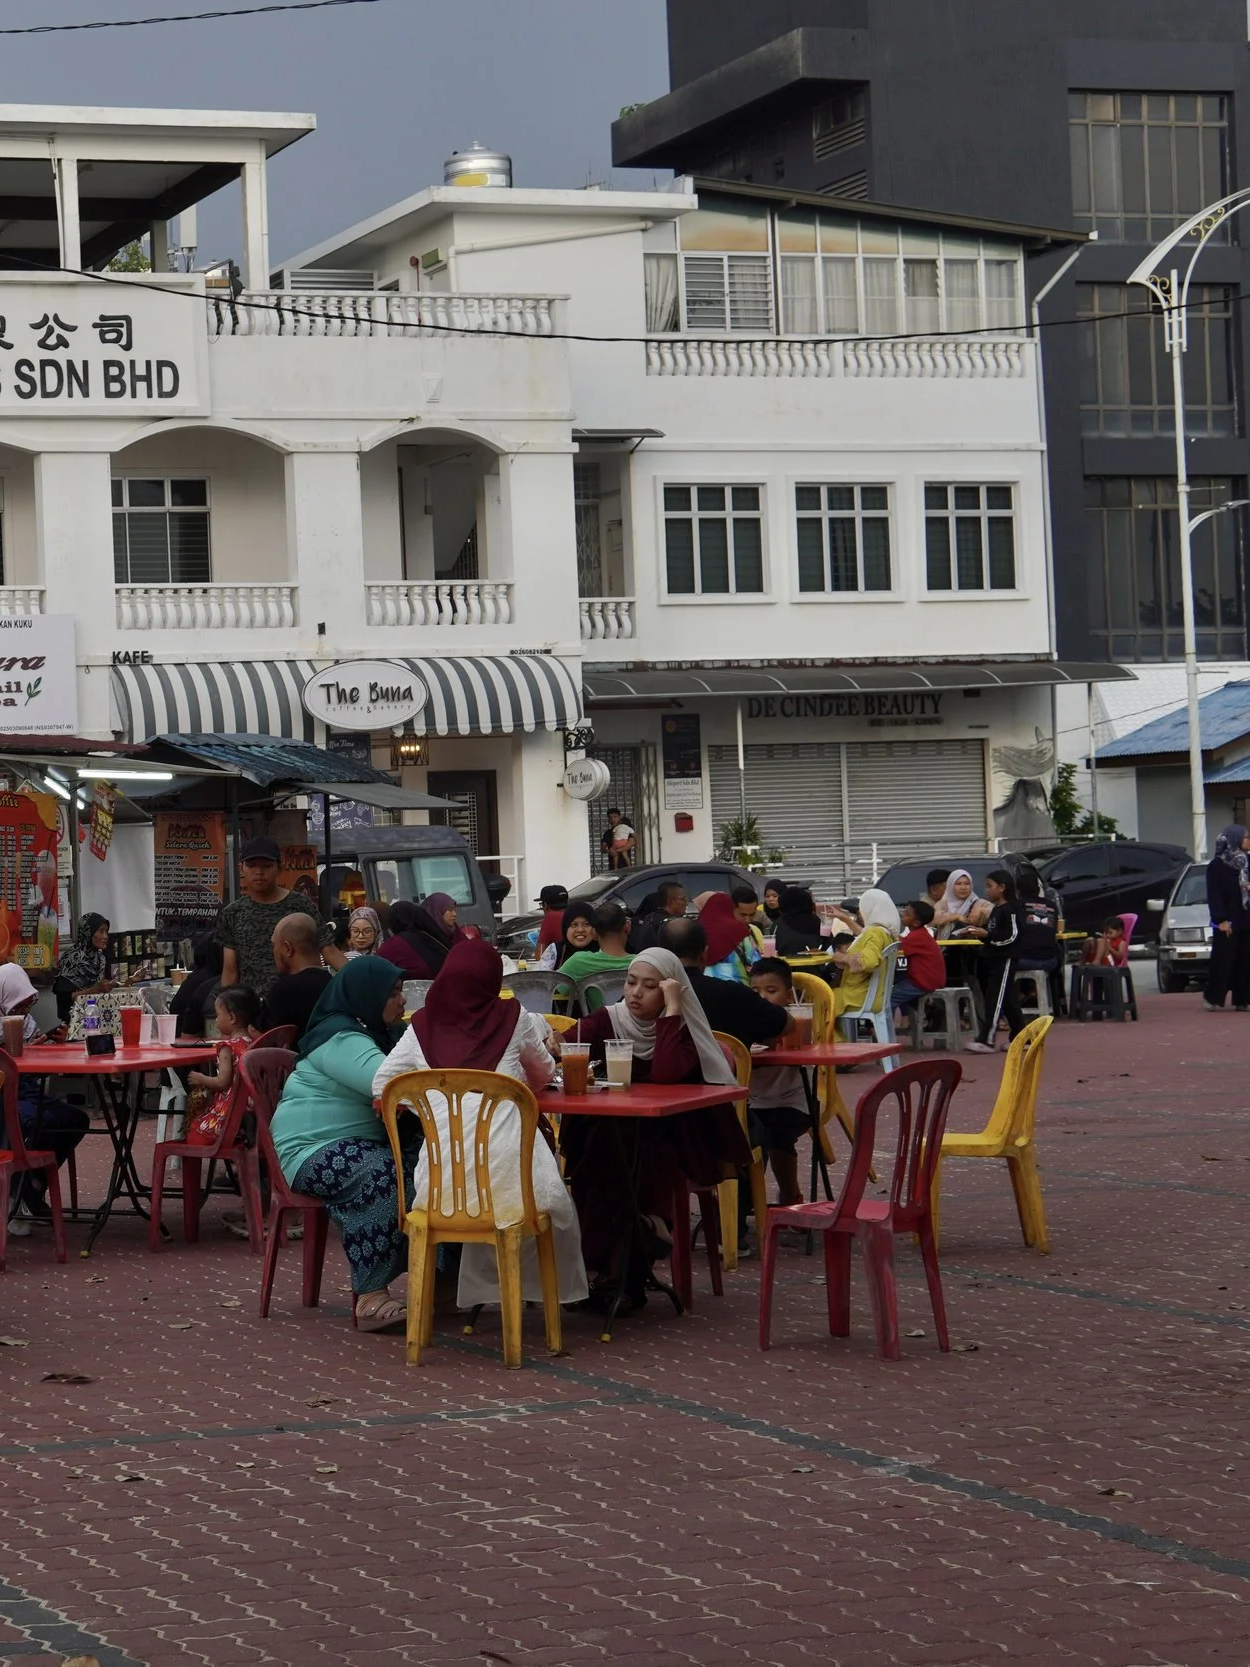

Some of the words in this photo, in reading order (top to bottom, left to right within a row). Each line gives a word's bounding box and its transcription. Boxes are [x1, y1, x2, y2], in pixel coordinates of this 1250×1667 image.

[14, 357, 90, 399] SDN
[104, 358, 181, 399] BHD
[14, 620, 33, 628] KUKU
[112, 651, 150, 664] KAFE
[318, 681, 360, 704] The
[369, 682, 414, 703] Buna
[748, 698, 776, 718] DE
[864, 694, 942, 716] BEAUTY
